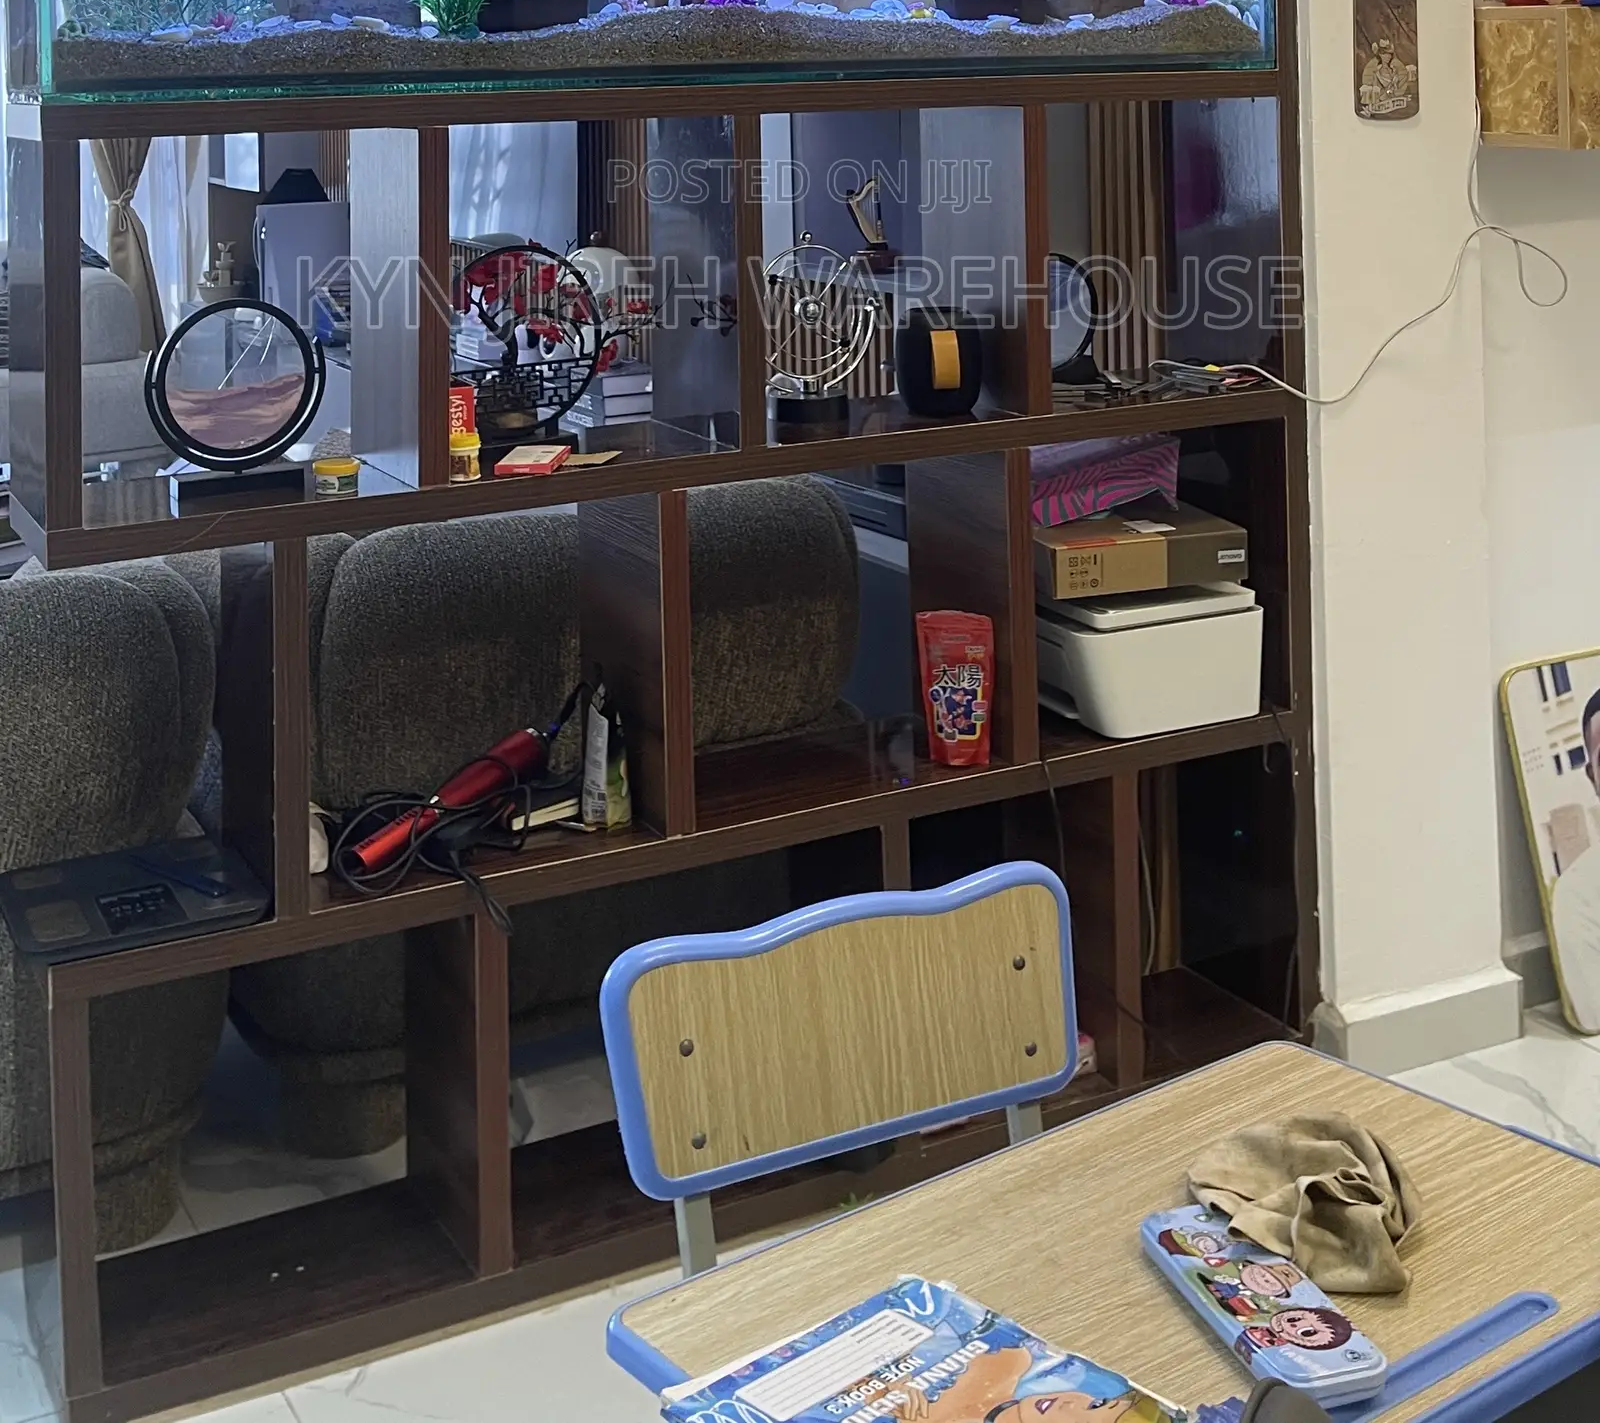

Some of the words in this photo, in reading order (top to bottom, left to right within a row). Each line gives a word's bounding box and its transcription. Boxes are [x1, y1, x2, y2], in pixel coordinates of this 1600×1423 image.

[932, 664, 984, 689] 太陽
[880, 1356, 926, 1383] NOTE
[904, 1340, 990, 1391] GHANA
[839, 1379, 887, 1408] BOOK
[826, 1404, 843, 1414] 3
